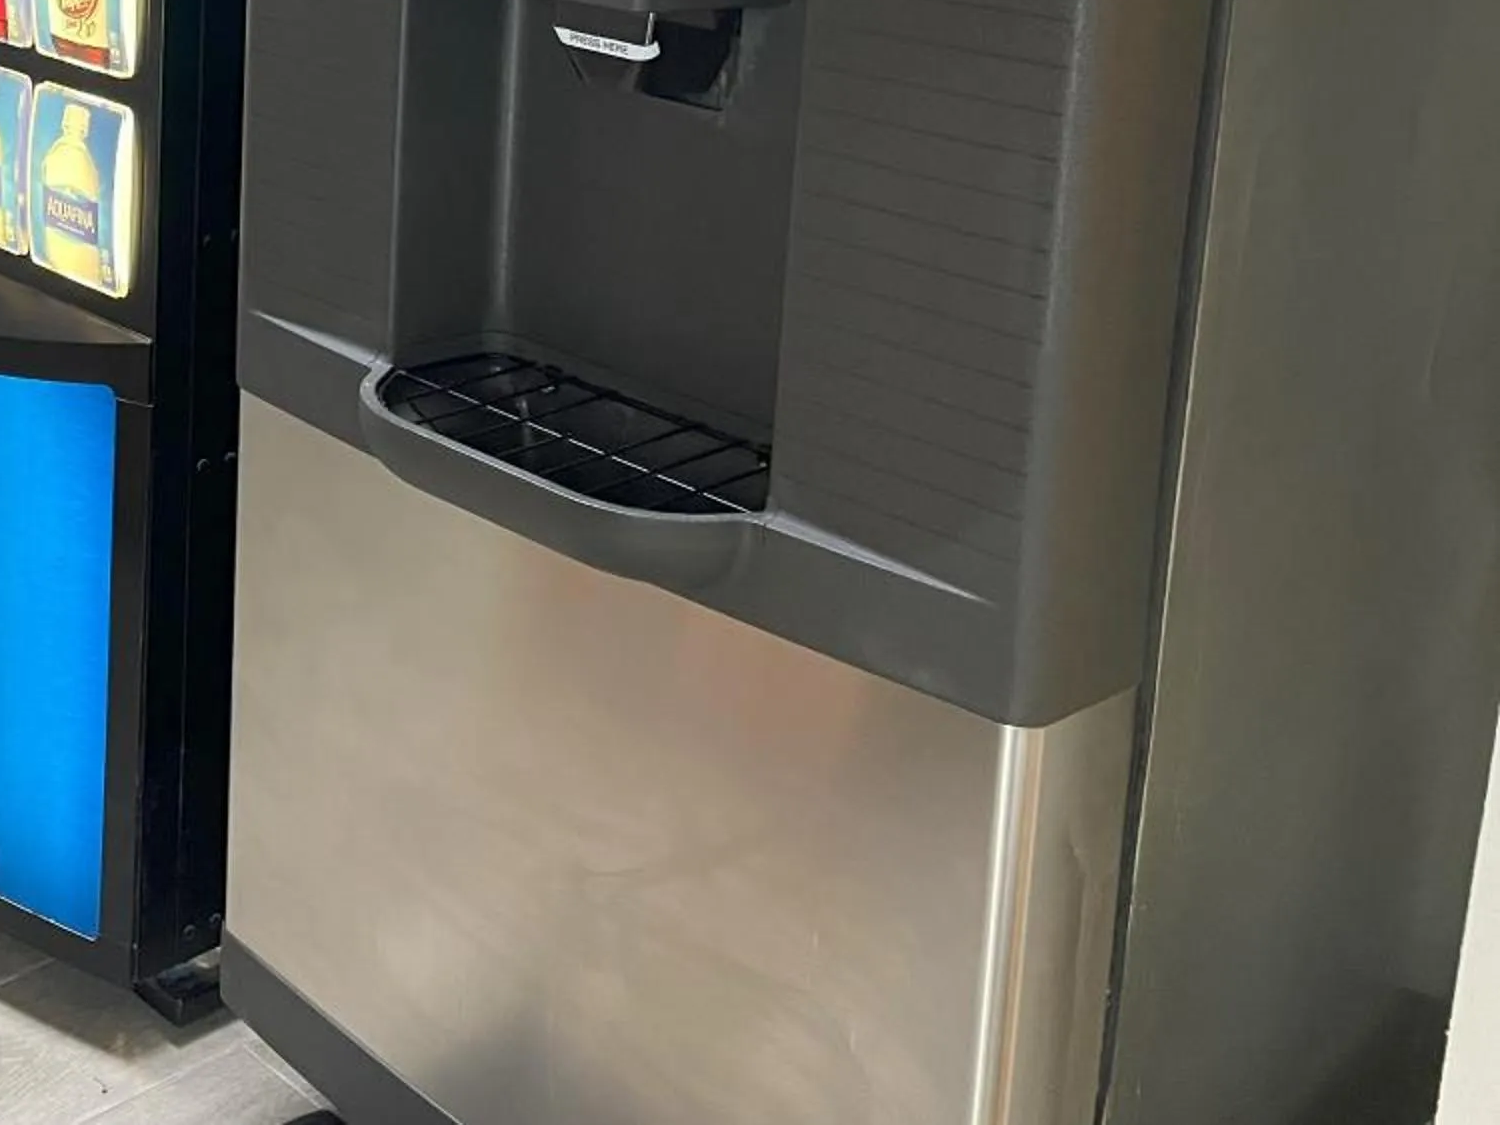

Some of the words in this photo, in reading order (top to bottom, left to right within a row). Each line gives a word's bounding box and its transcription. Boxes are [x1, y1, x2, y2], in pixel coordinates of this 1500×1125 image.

[569, 33, 601, 49] PRESS
[603, 40, 629, 56] HERE
[47, 195, 94, 230] AQUAFINA
